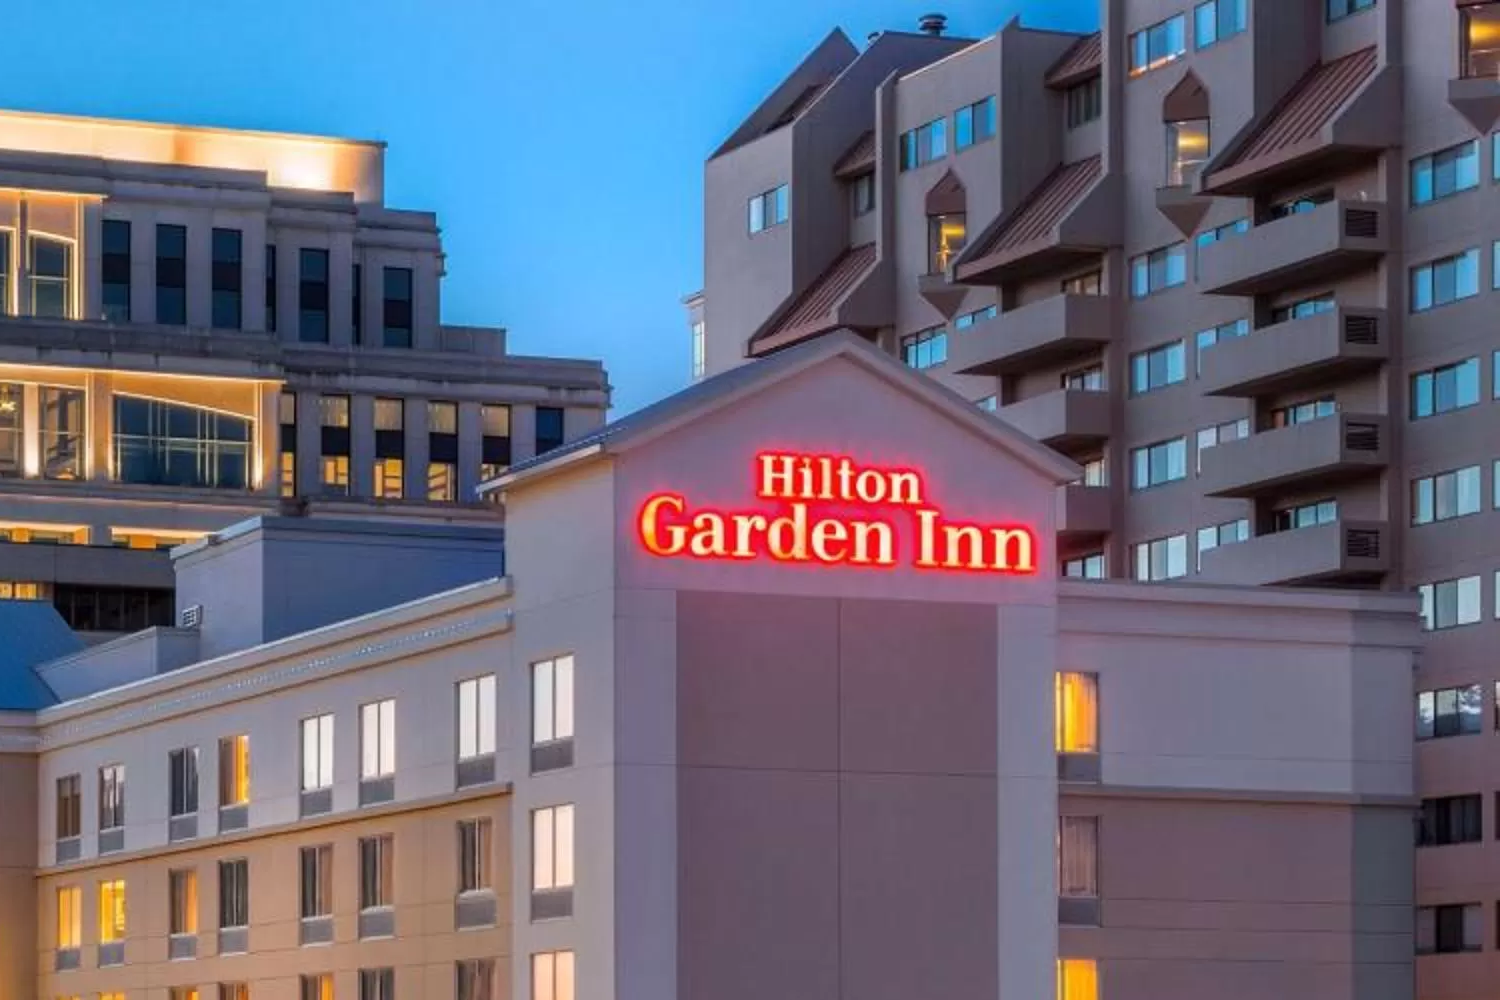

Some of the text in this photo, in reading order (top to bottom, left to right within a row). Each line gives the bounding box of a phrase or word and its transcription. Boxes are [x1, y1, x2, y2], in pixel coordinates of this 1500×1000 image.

[758, 453, 923, 505] Hilton
[640, 495, 1036, 573] Garden Inn
